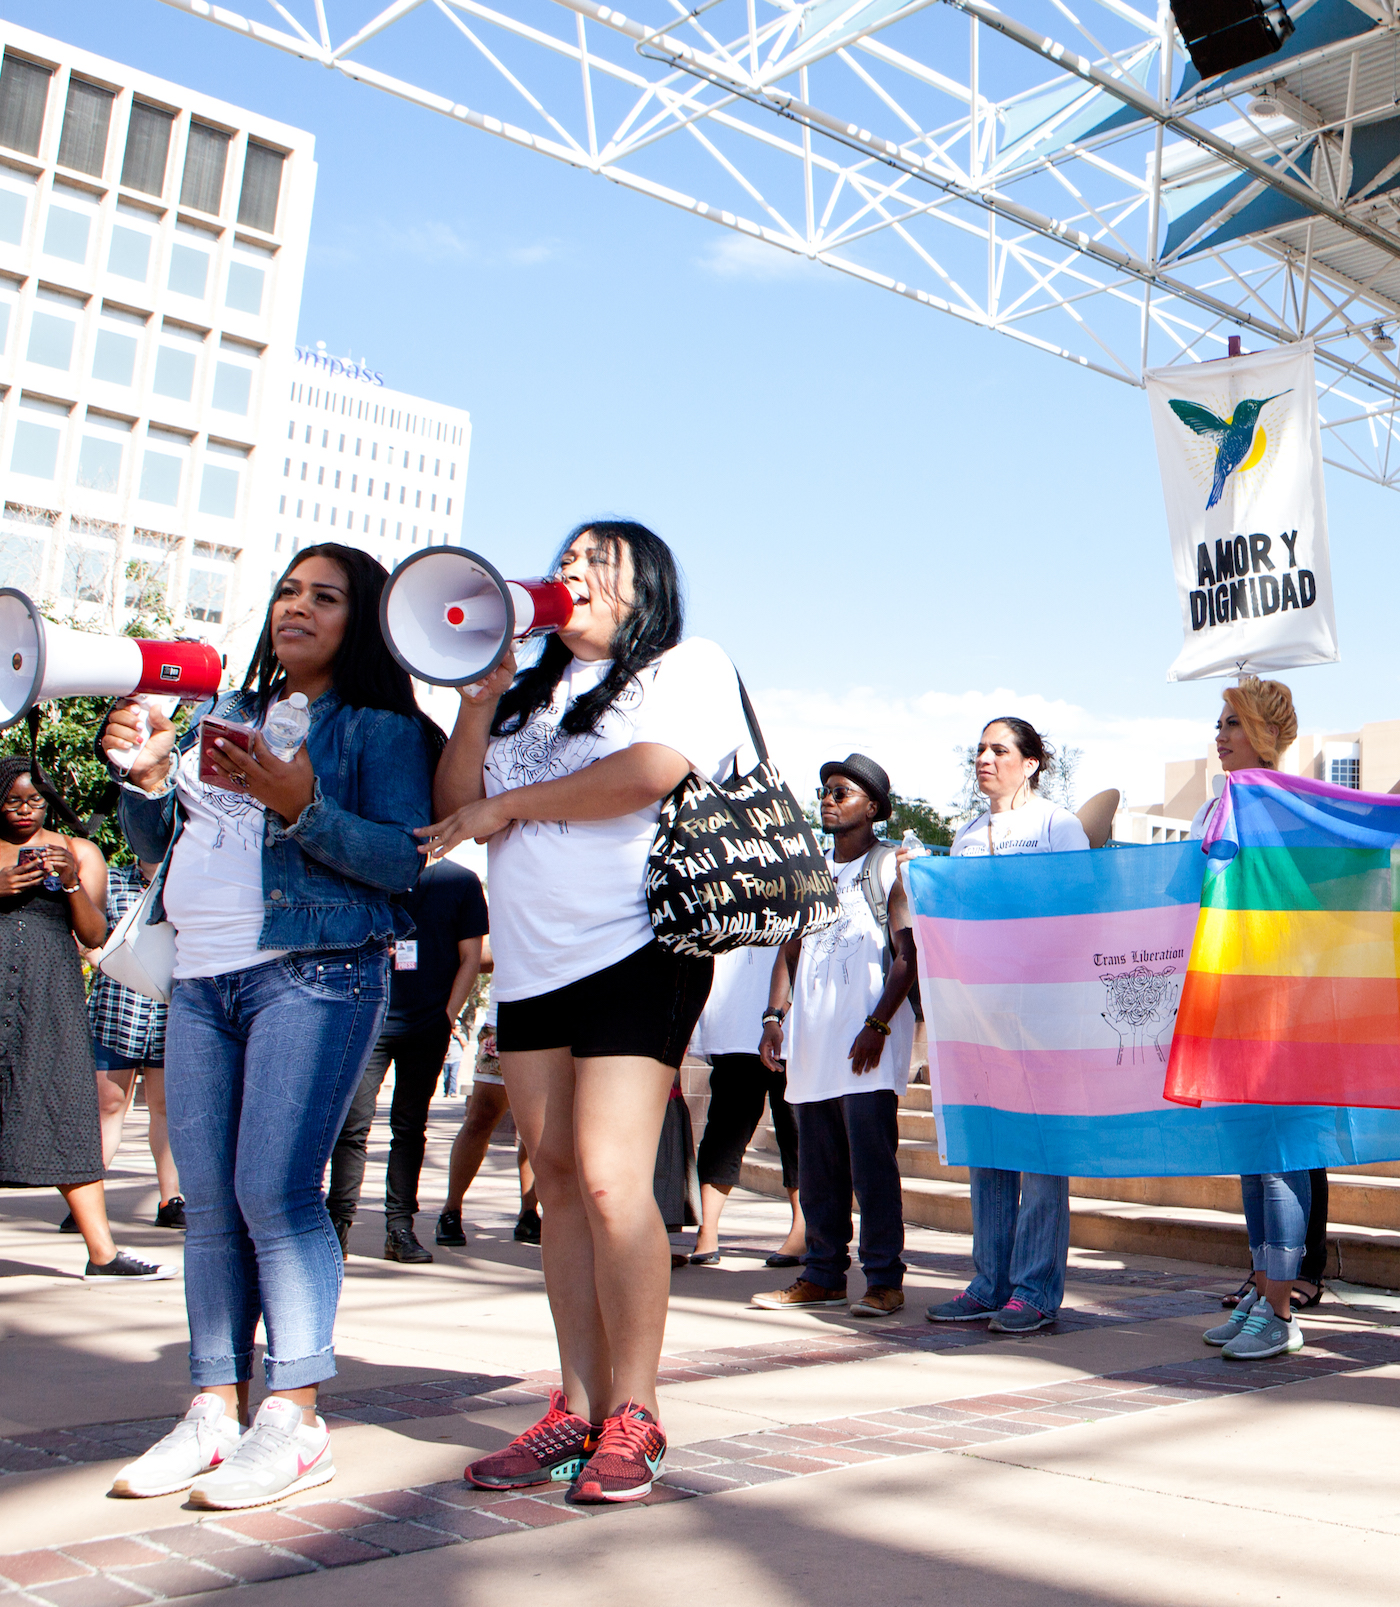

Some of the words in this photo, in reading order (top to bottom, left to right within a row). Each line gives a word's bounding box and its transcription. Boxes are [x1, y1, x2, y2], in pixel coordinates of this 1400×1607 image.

[1197, 532, 1276, 587] AMOR
[1280, 529, 1298, 569] Y
[1189, 569, 1317, 632] DIGNIDAD
[678, 808, 741, 839] FROM
[732, 870, 787, 901] FROM
[1092, 953, 1127, 967] Trans
[1130, 946, 1185, 964] Liberation
